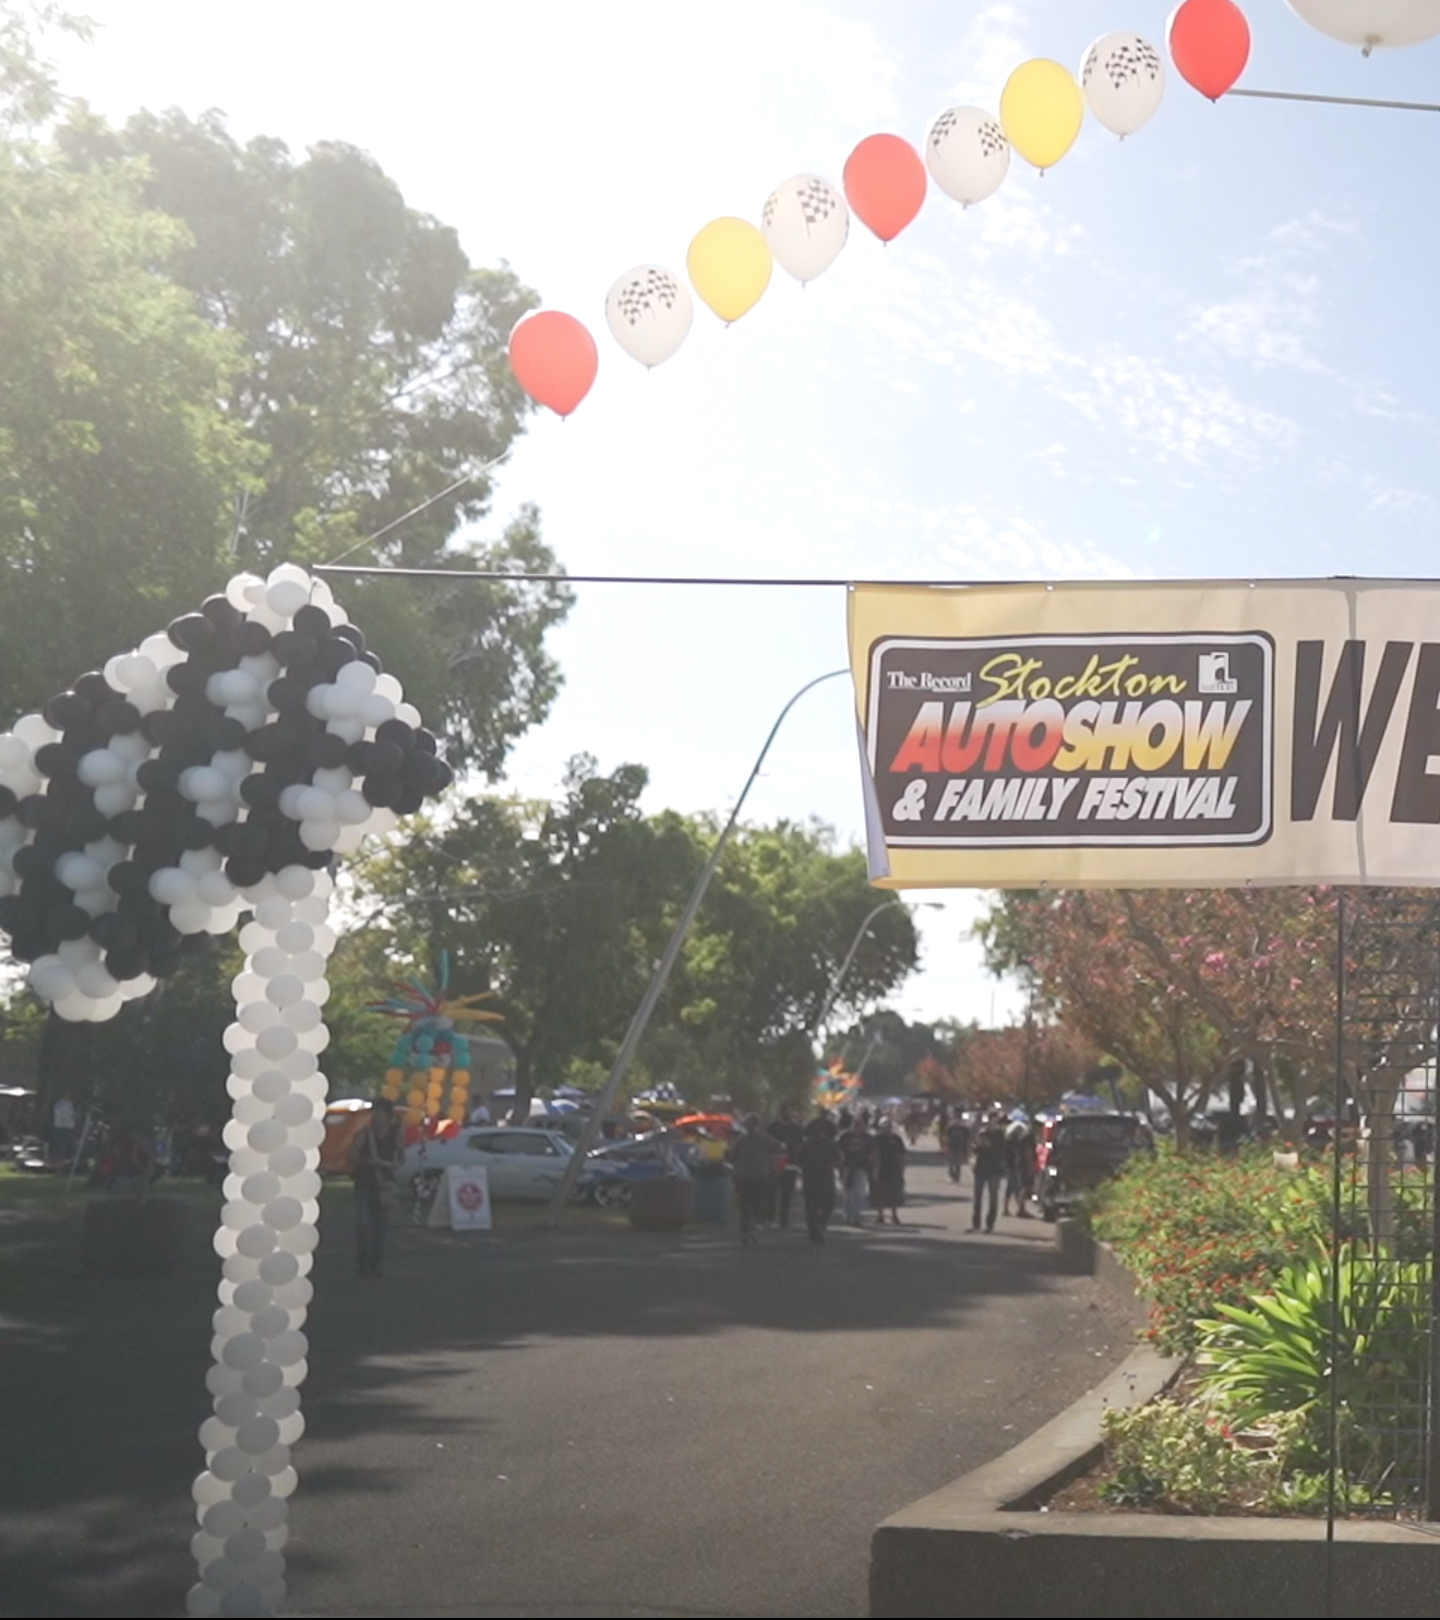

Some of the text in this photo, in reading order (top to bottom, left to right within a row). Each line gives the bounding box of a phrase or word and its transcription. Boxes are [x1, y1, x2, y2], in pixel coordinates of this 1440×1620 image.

[887, 670, 971, 692] The Record
[977, 653, 1187, 708] Stockton
[892, 776, 1238, 821] & FAMILY FESTIVAL
